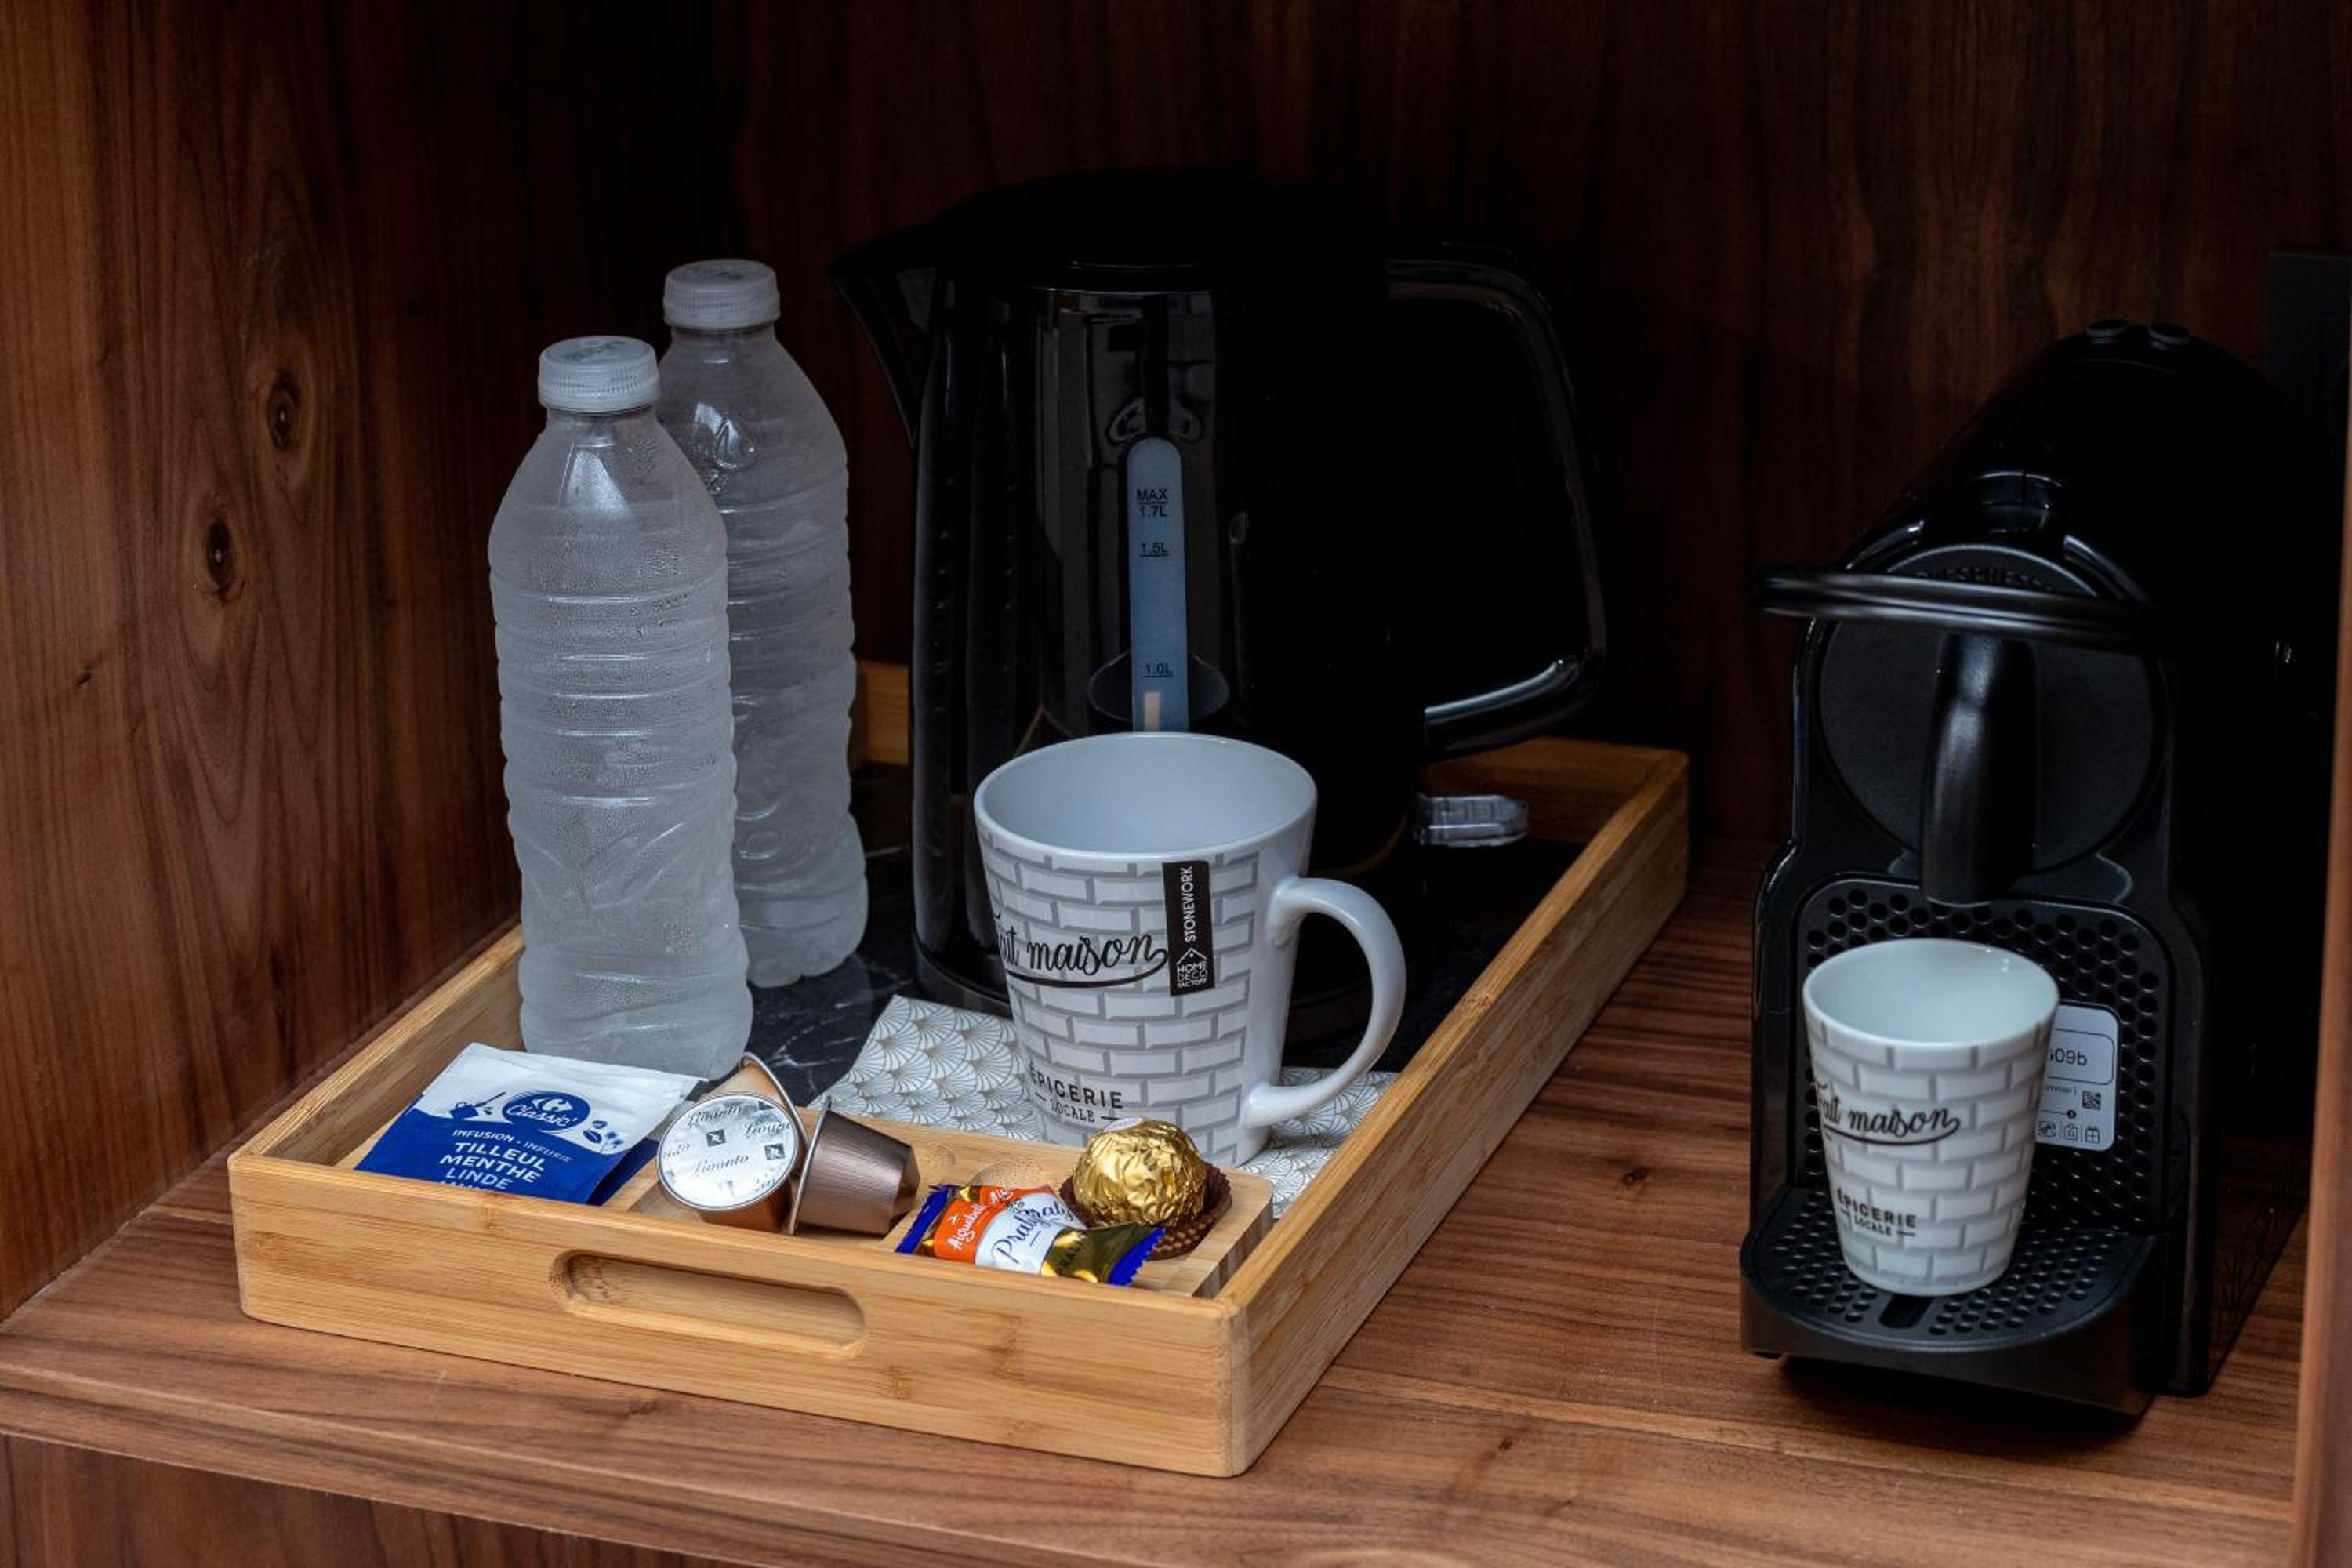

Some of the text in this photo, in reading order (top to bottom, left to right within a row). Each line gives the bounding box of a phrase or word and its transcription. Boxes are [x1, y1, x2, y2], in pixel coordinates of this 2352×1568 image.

[1136, 488, 1167, 501] MAX
[1140, 506, 1167, 517] 1.7L
[1141, 542, 1169, 553] 1.5L
[1144, 663, 1174, 676] 1.0L
[1181, 866, 1197, 942] STONEWORK
[996, 914, 1168, 976] ait maison
[1177, 961, 1207, 974] HOME
[2049, 1047, 2088, 1067] 09b
[1051, 1100, 1095, 1123] LOCALE
[1848, 1107, 1960, 1138] maison
[452, 1129, 515, 1142] INFUSION
[454, 1142, 546, 1171] TILLEUL
[438, 1154, 541, 1183] MENTHE
[445, 1167, 514, 1189] LINDE
[1854, 1214, 1892, 1236] LOCALE
